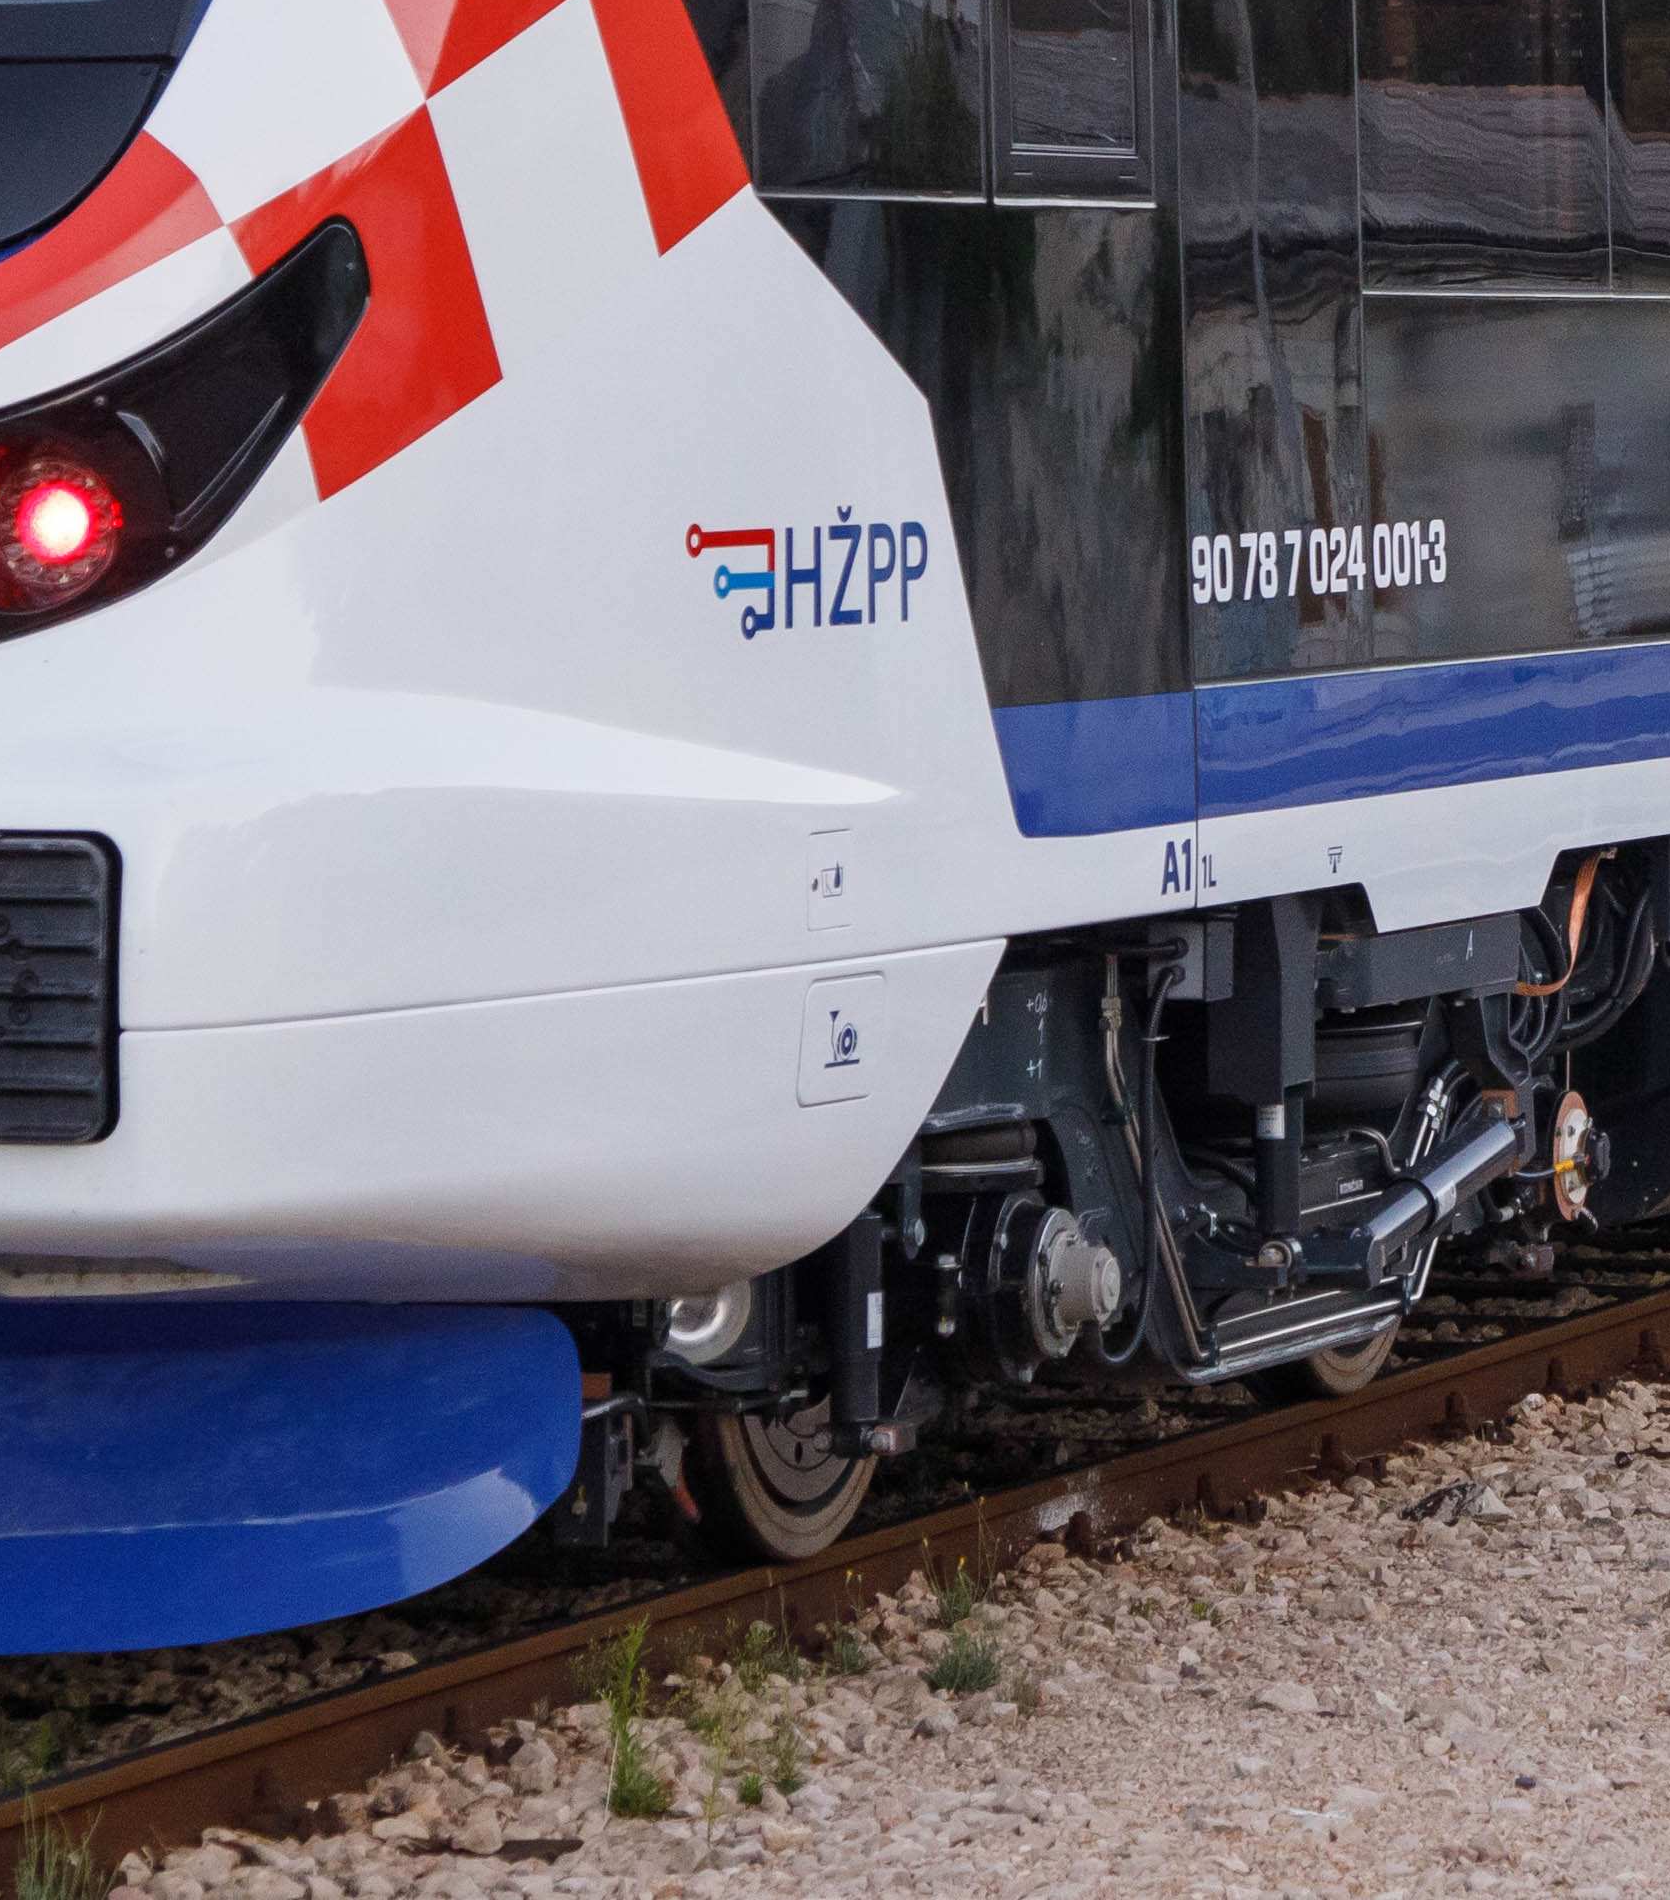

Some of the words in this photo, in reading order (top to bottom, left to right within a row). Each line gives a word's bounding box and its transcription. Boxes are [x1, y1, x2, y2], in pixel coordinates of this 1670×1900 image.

[784, 505, 928, 630] HŽPP
[1191, 534, 1234, 604] 90
[1239, 531, 1278, 600] 78
[1283, 529, 1302, 597] 7
[1309, 525, 1366, 595] 024
[1373, 518, 1447, 589] 001-3
[1161, 838, 1192, 896] A1
[1201, 853, 1217, 889] 1L
